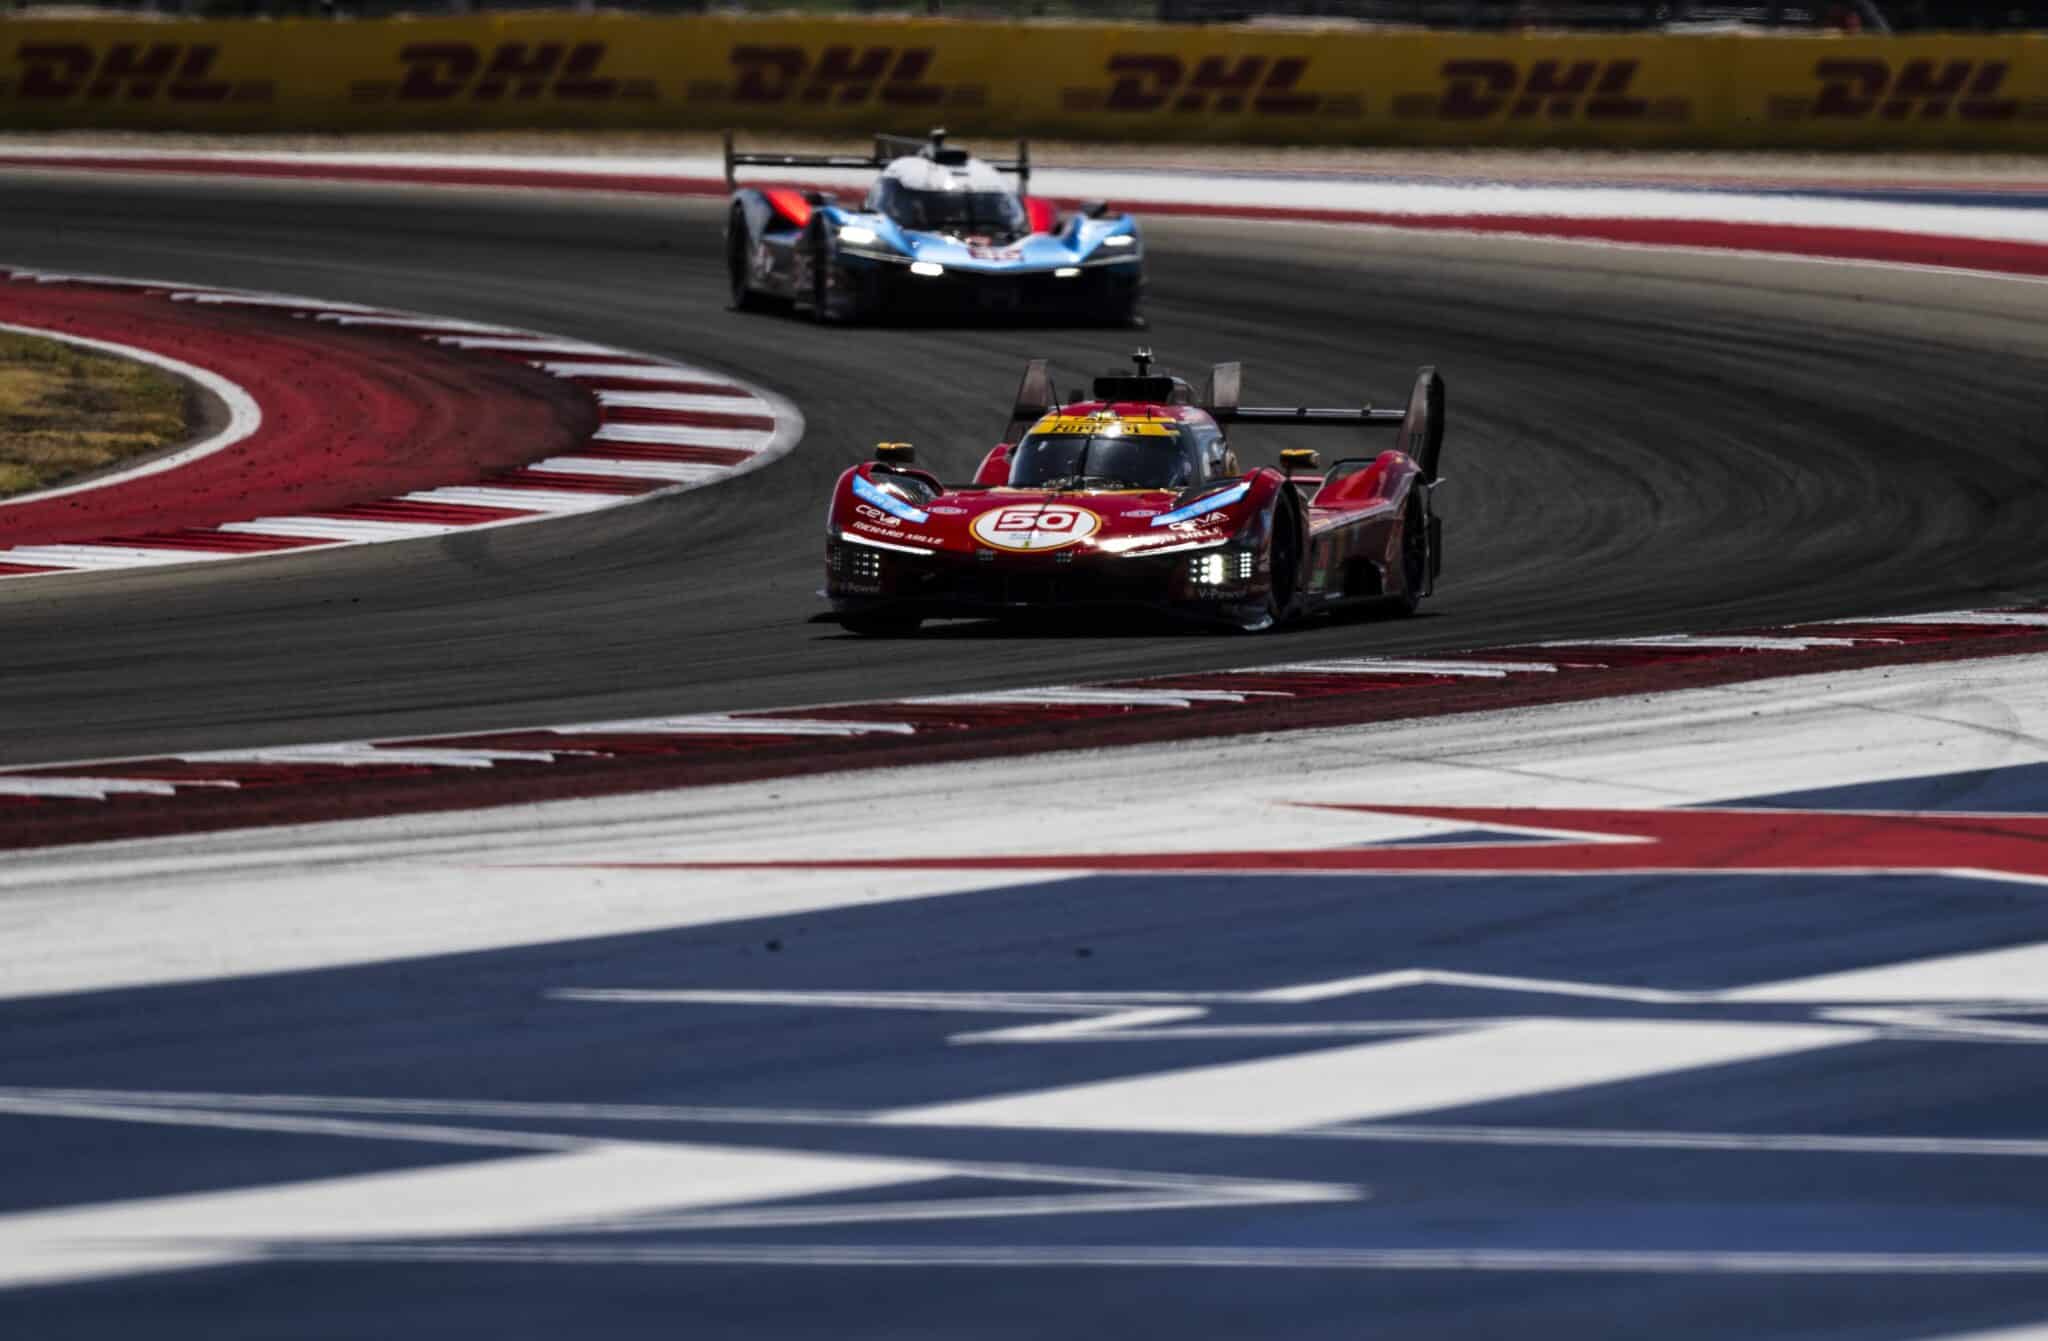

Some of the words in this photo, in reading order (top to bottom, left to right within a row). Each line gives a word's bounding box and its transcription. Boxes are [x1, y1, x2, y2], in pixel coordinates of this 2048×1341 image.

[16, 42, 232, 99] DHL
[396, 42, 619, 99] DHL
[729, 47, 945, 103] DHL
[1104, 54, 1320, 112] DHL
[1438, 58, 1649, 118] DHL
[1810, 59, 2017, 119] DHL
[852, 520, 905, 539] RICHARD
[904, 533, 944, 545] MILLE
[998, 510, 1075, 531] 50
